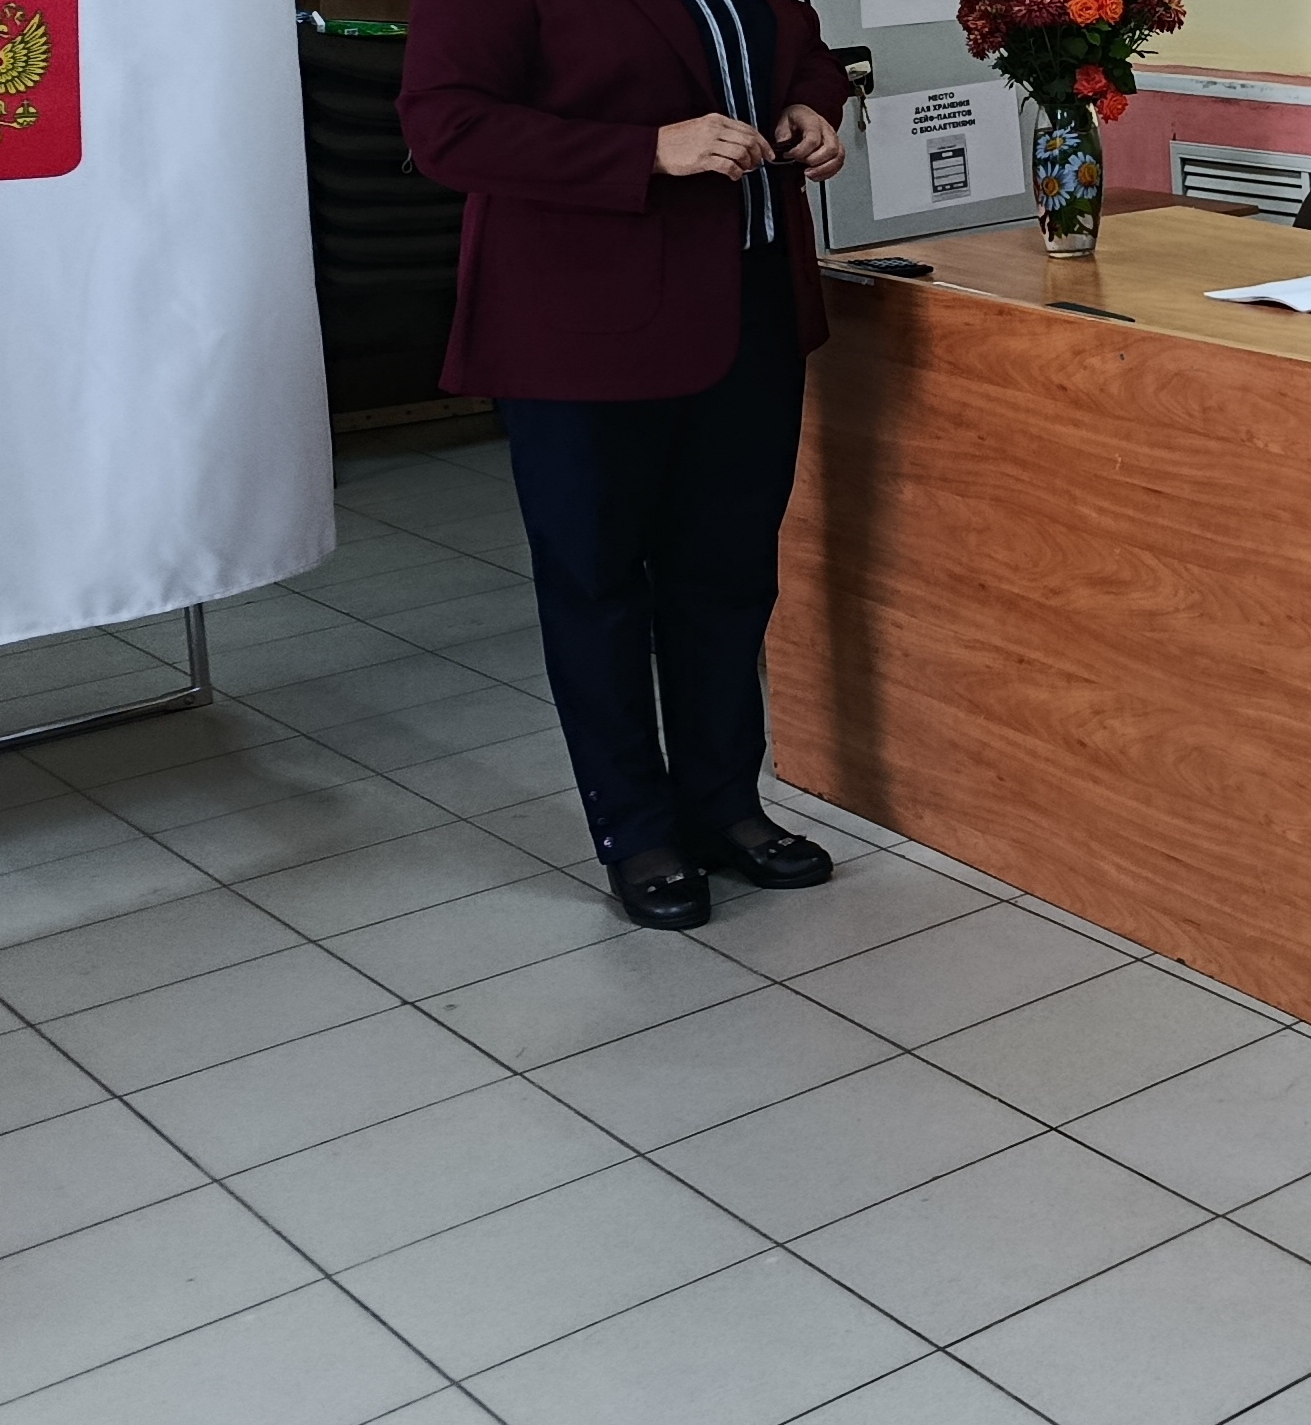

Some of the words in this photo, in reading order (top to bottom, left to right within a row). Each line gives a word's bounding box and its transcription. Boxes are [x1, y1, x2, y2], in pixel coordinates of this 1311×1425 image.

[928, 92, 955, 102] МЕСТО
[914, 105, 931, 115] ДЛЯ
[932, 99, 970, 112] ХРАНЕНИЯ
[913, 109, 972, 125] СЕЙФ-ПАКЕТОВ
[920, 119, 976, 134] БЮЛЛЕТЕНЯМИ
